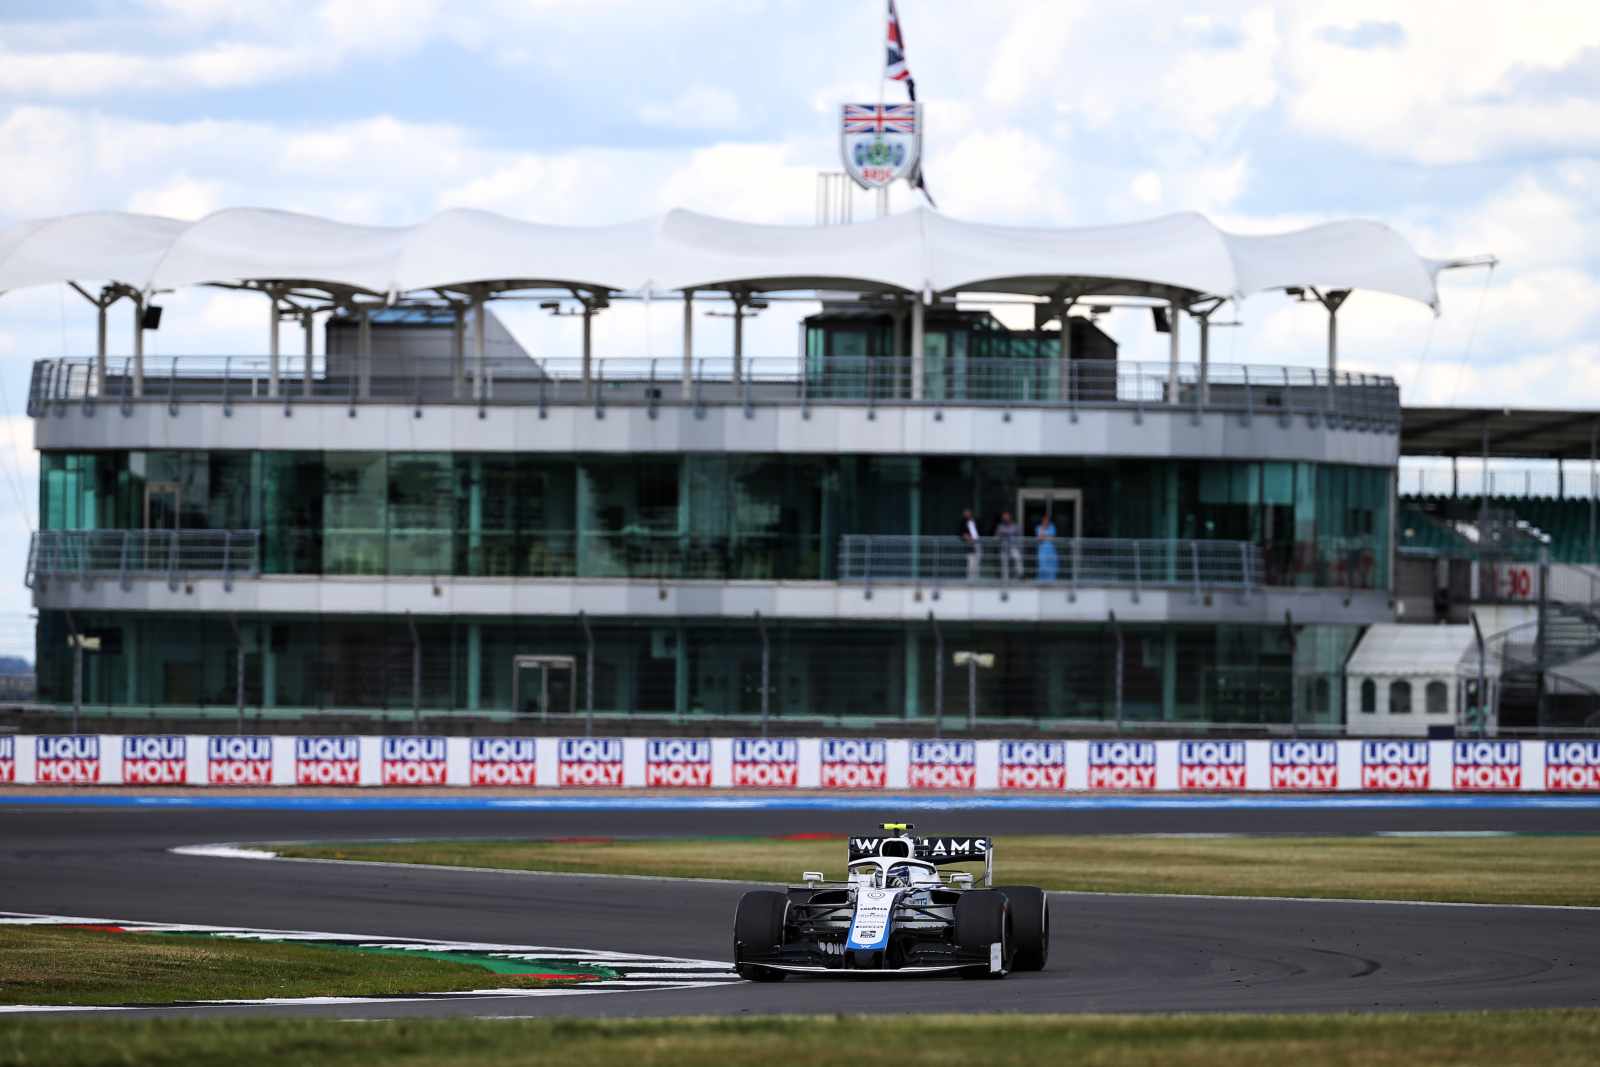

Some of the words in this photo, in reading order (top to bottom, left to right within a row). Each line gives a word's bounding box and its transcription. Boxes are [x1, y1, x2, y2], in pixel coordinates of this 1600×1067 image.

[38, 737, 99, 759] LIQUI
[124, 738, 185, 759] LIQUI
[211, 738, 270, 760] LIQUI
[298, 738, 359, 760] LIQUI
[384, 738, 445, 760] LIQUI
[473, 739, 535, 761] LIQUI
[560, 739, 622, 761] LIQUI
[649, 740, 711, 762] LIQUI
[734, 739, 796, 761] LIQUI
[823, 740, 885, 762] LIQUI
[910, 741, 974, 764] LIQUI
[1001, 742, 1065, 765] LIQUI
[1091, 742, 1154, 765] LIQUI
[1181, 741, 1245, 765] LIQUI
[1273, 741, 1336, 765] LIQUI
[1364, 741, 1428, 765] LIQUI
[1456, 741, 1520, 765] LIQUI
[1547, 741, 1600, 765] LIQU
[38, 759, 99, 782] MOLY
[124, 759, 185, 782] MOLY
[211, 760, 270, 783] MOLY
[298, 760, 359, 783] MOLY
[384, 760, 445, 783] MOLY
[473, 761, 535, 784] MOLY
[560, 761, 622, 784] MOLY
[649, 762, 711, 785] MOLY
[734, 761, 796, 784] MOLY
[823, 762, 885, 785] MOLY
[910, 764, 974, 787] MOLY
[1001, 765, 1065, 788] MOLY
[1091, 765, 1154, 788] MOLY
[1181, 765, 1245, 788] MOLY
[1273, 765, 1336, 788] MOLY
[1364, 765, 1428, 788] MOLY
[1456, 765, 1520, 788] MOLY
